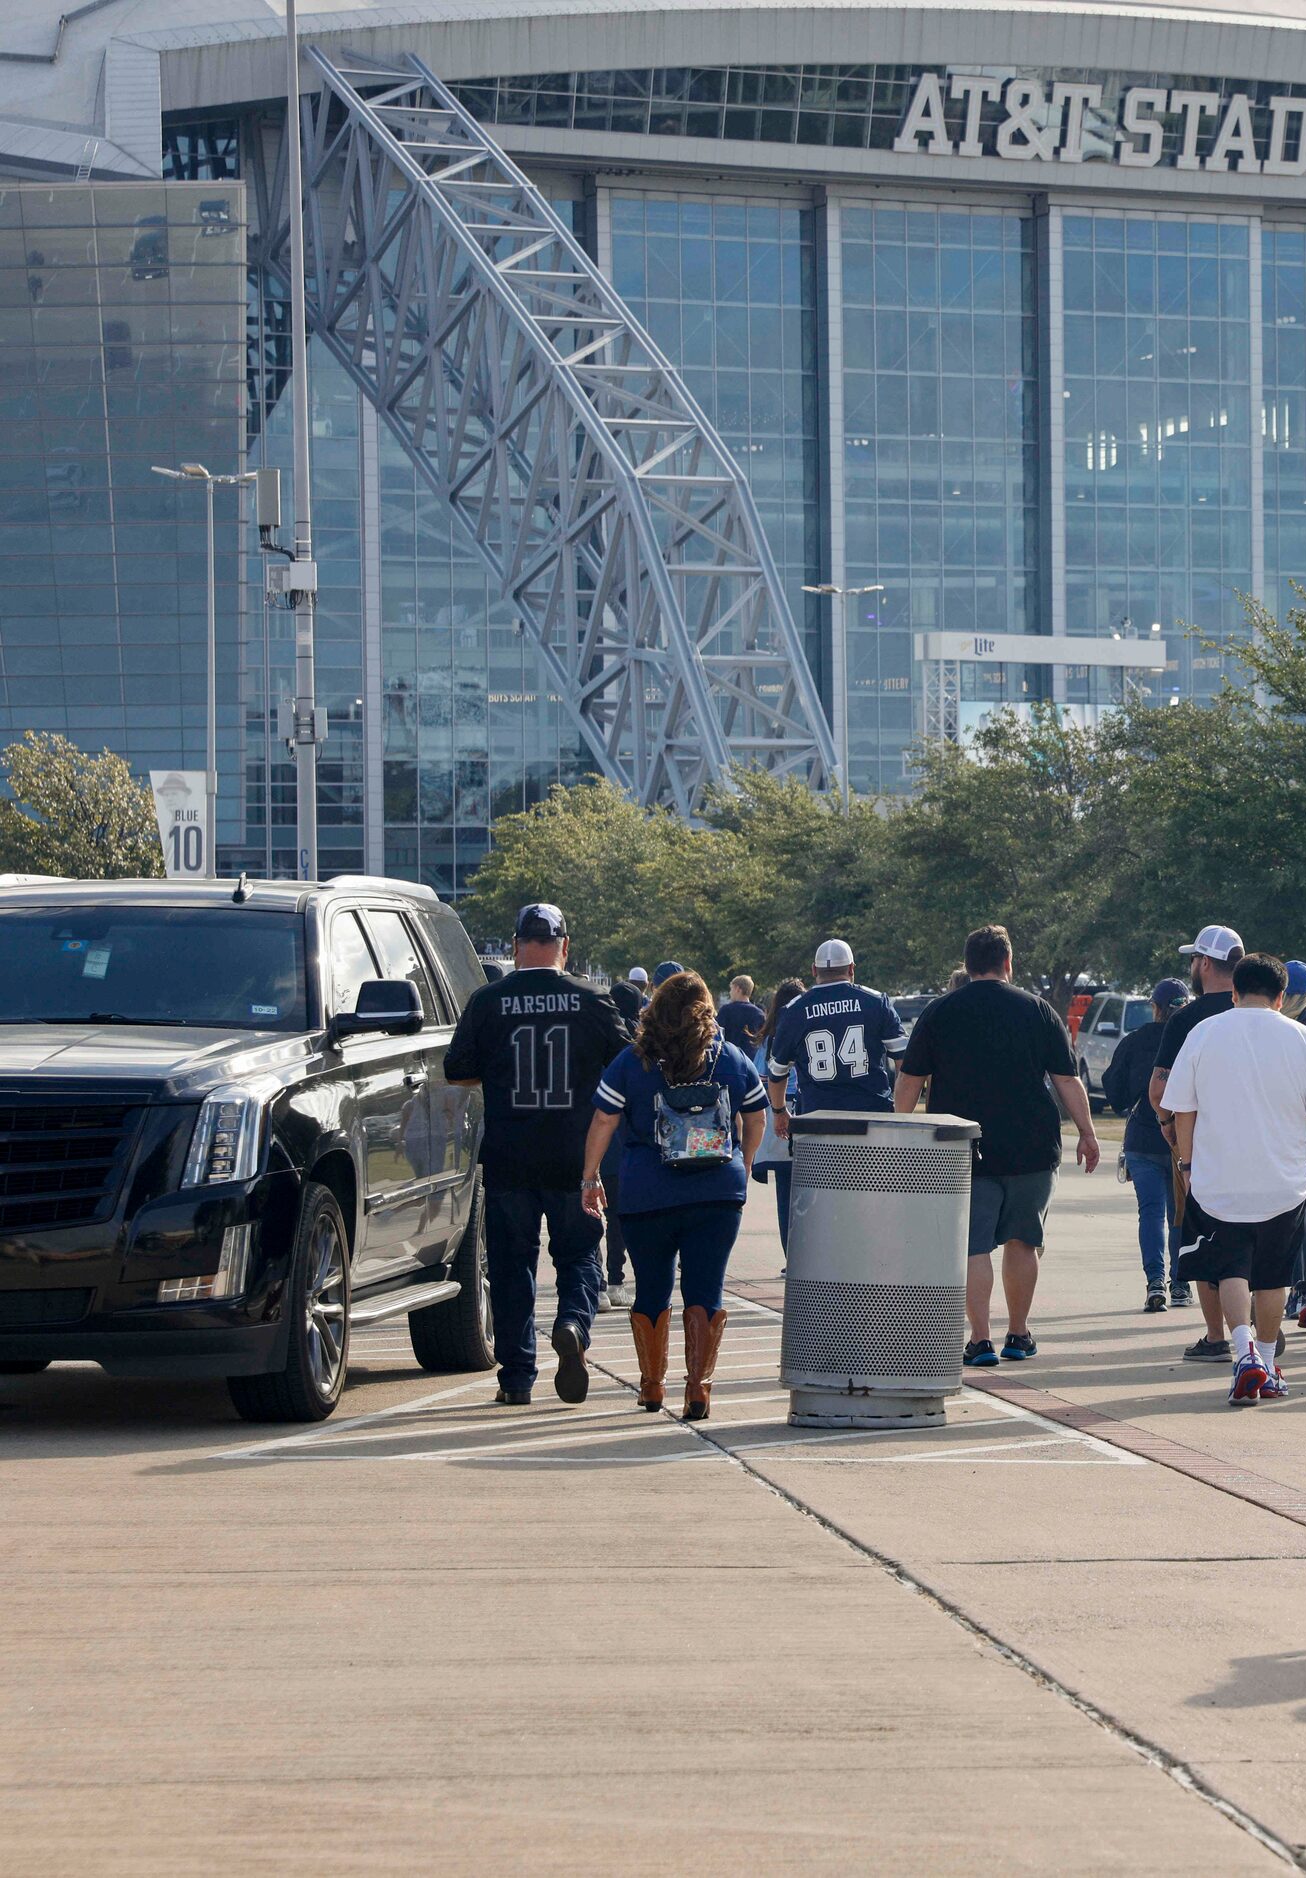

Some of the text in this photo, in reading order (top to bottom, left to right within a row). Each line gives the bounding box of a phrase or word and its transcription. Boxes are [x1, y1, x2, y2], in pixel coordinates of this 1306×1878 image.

[894, 72, 1103, 164] AT&T
[974, 637, 995, 656] Lite
[175, 809, 199, 822] BLUE
[168, 825, 203, 871] 10
[501, 993, 581, 1015] PARSONS
[805, 999, 862, 1020] LONGORIA
[510, 1025, 573, 1108] 11
[804, 1024, 869, 1081] 84
